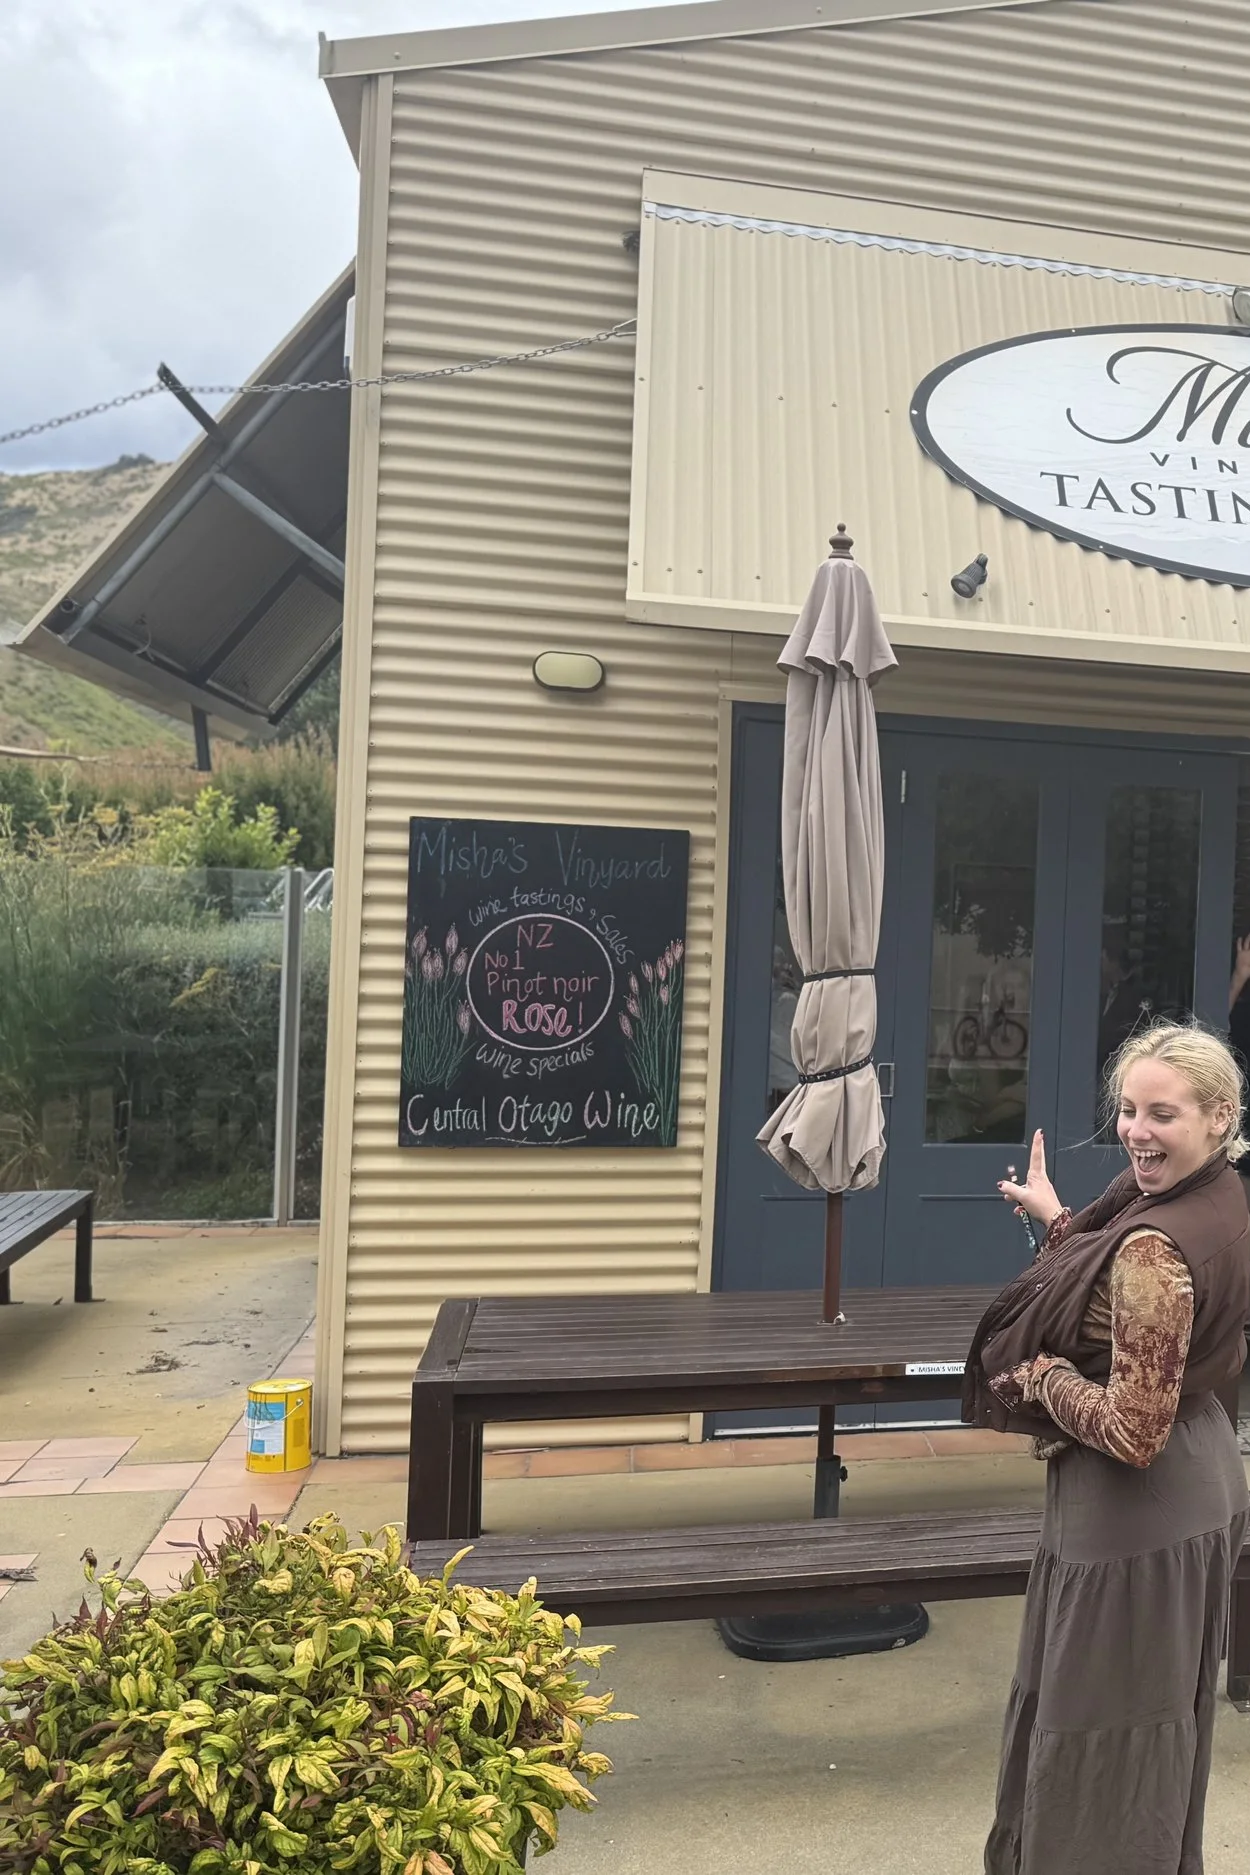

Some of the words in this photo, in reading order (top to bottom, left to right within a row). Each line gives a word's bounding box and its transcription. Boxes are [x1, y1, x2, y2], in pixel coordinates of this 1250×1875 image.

[555, 829, 671, 888] Vinyard
[511, 886, 586, 915] tastings
[517, 923, 554, 948] NZ
[484, 950, 508, 970] No
[512, 950, 525, 970] 1
[486, 972, 547, 1002] Pinot
[553, 970, 600, 1001] noir
[527, 1040, 594, 1080] specials
[407, 1094, 486, 1135] Central
[499, 1094, 573, 1136] Otago
[584, 1089, 660, 1137] Wine
